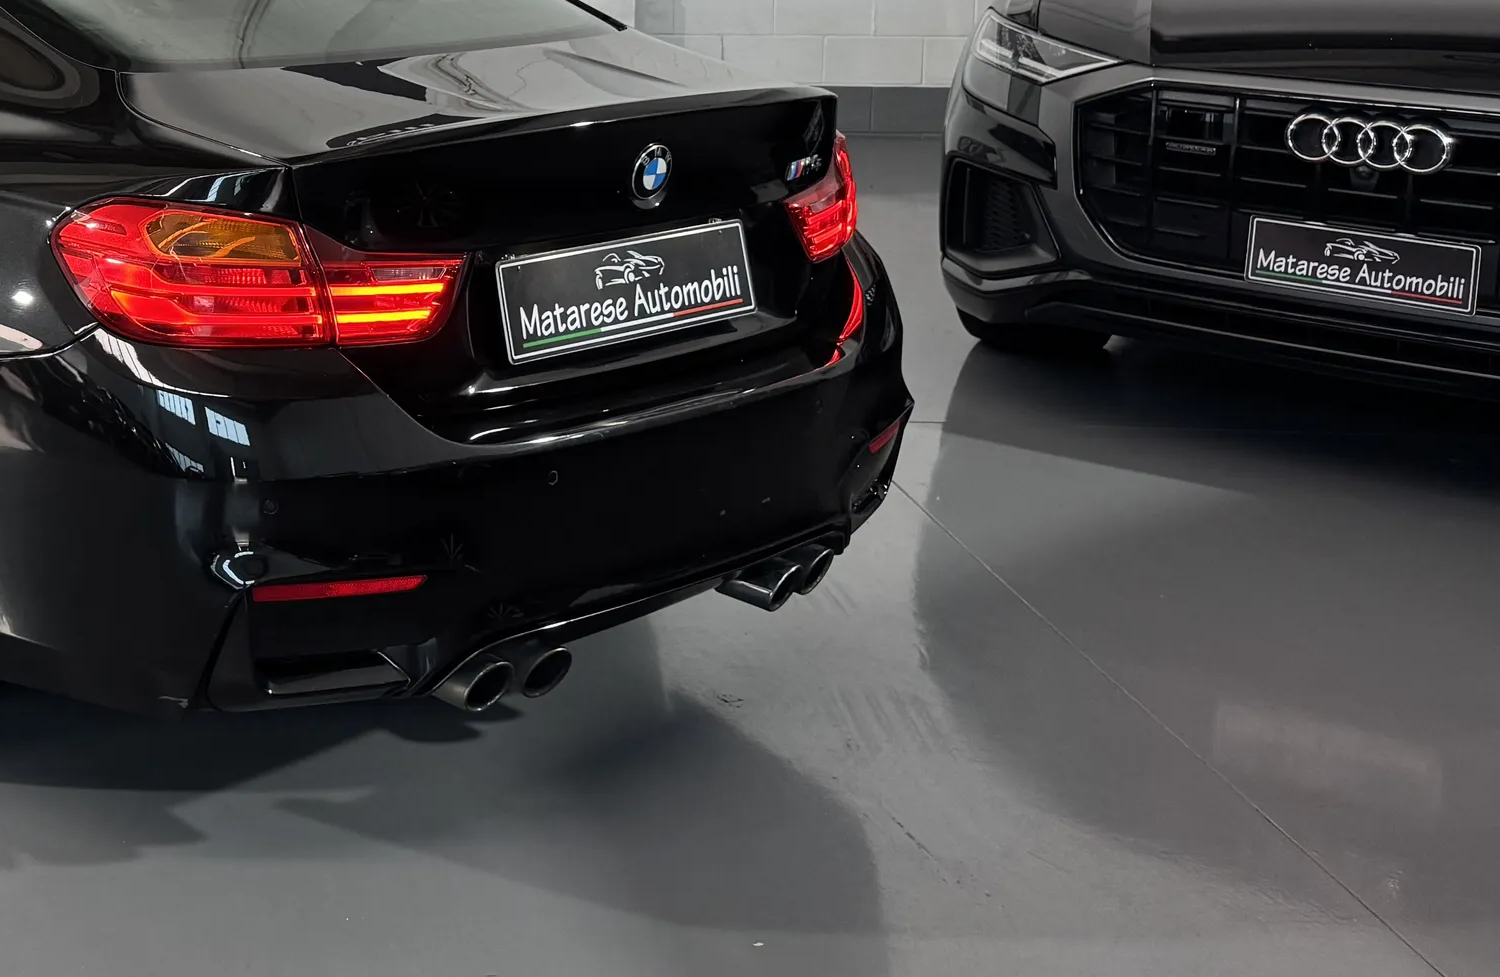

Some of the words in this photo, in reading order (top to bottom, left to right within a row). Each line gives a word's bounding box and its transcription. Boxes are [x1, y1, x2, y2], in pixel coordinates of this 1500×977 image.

[519, 296, 629, 340] Matarese
[634, 265, 742, 317] Automobili
[1256, 247, 1351, 283] Matarese
[1355, 262, 1466, 300] Automobili
